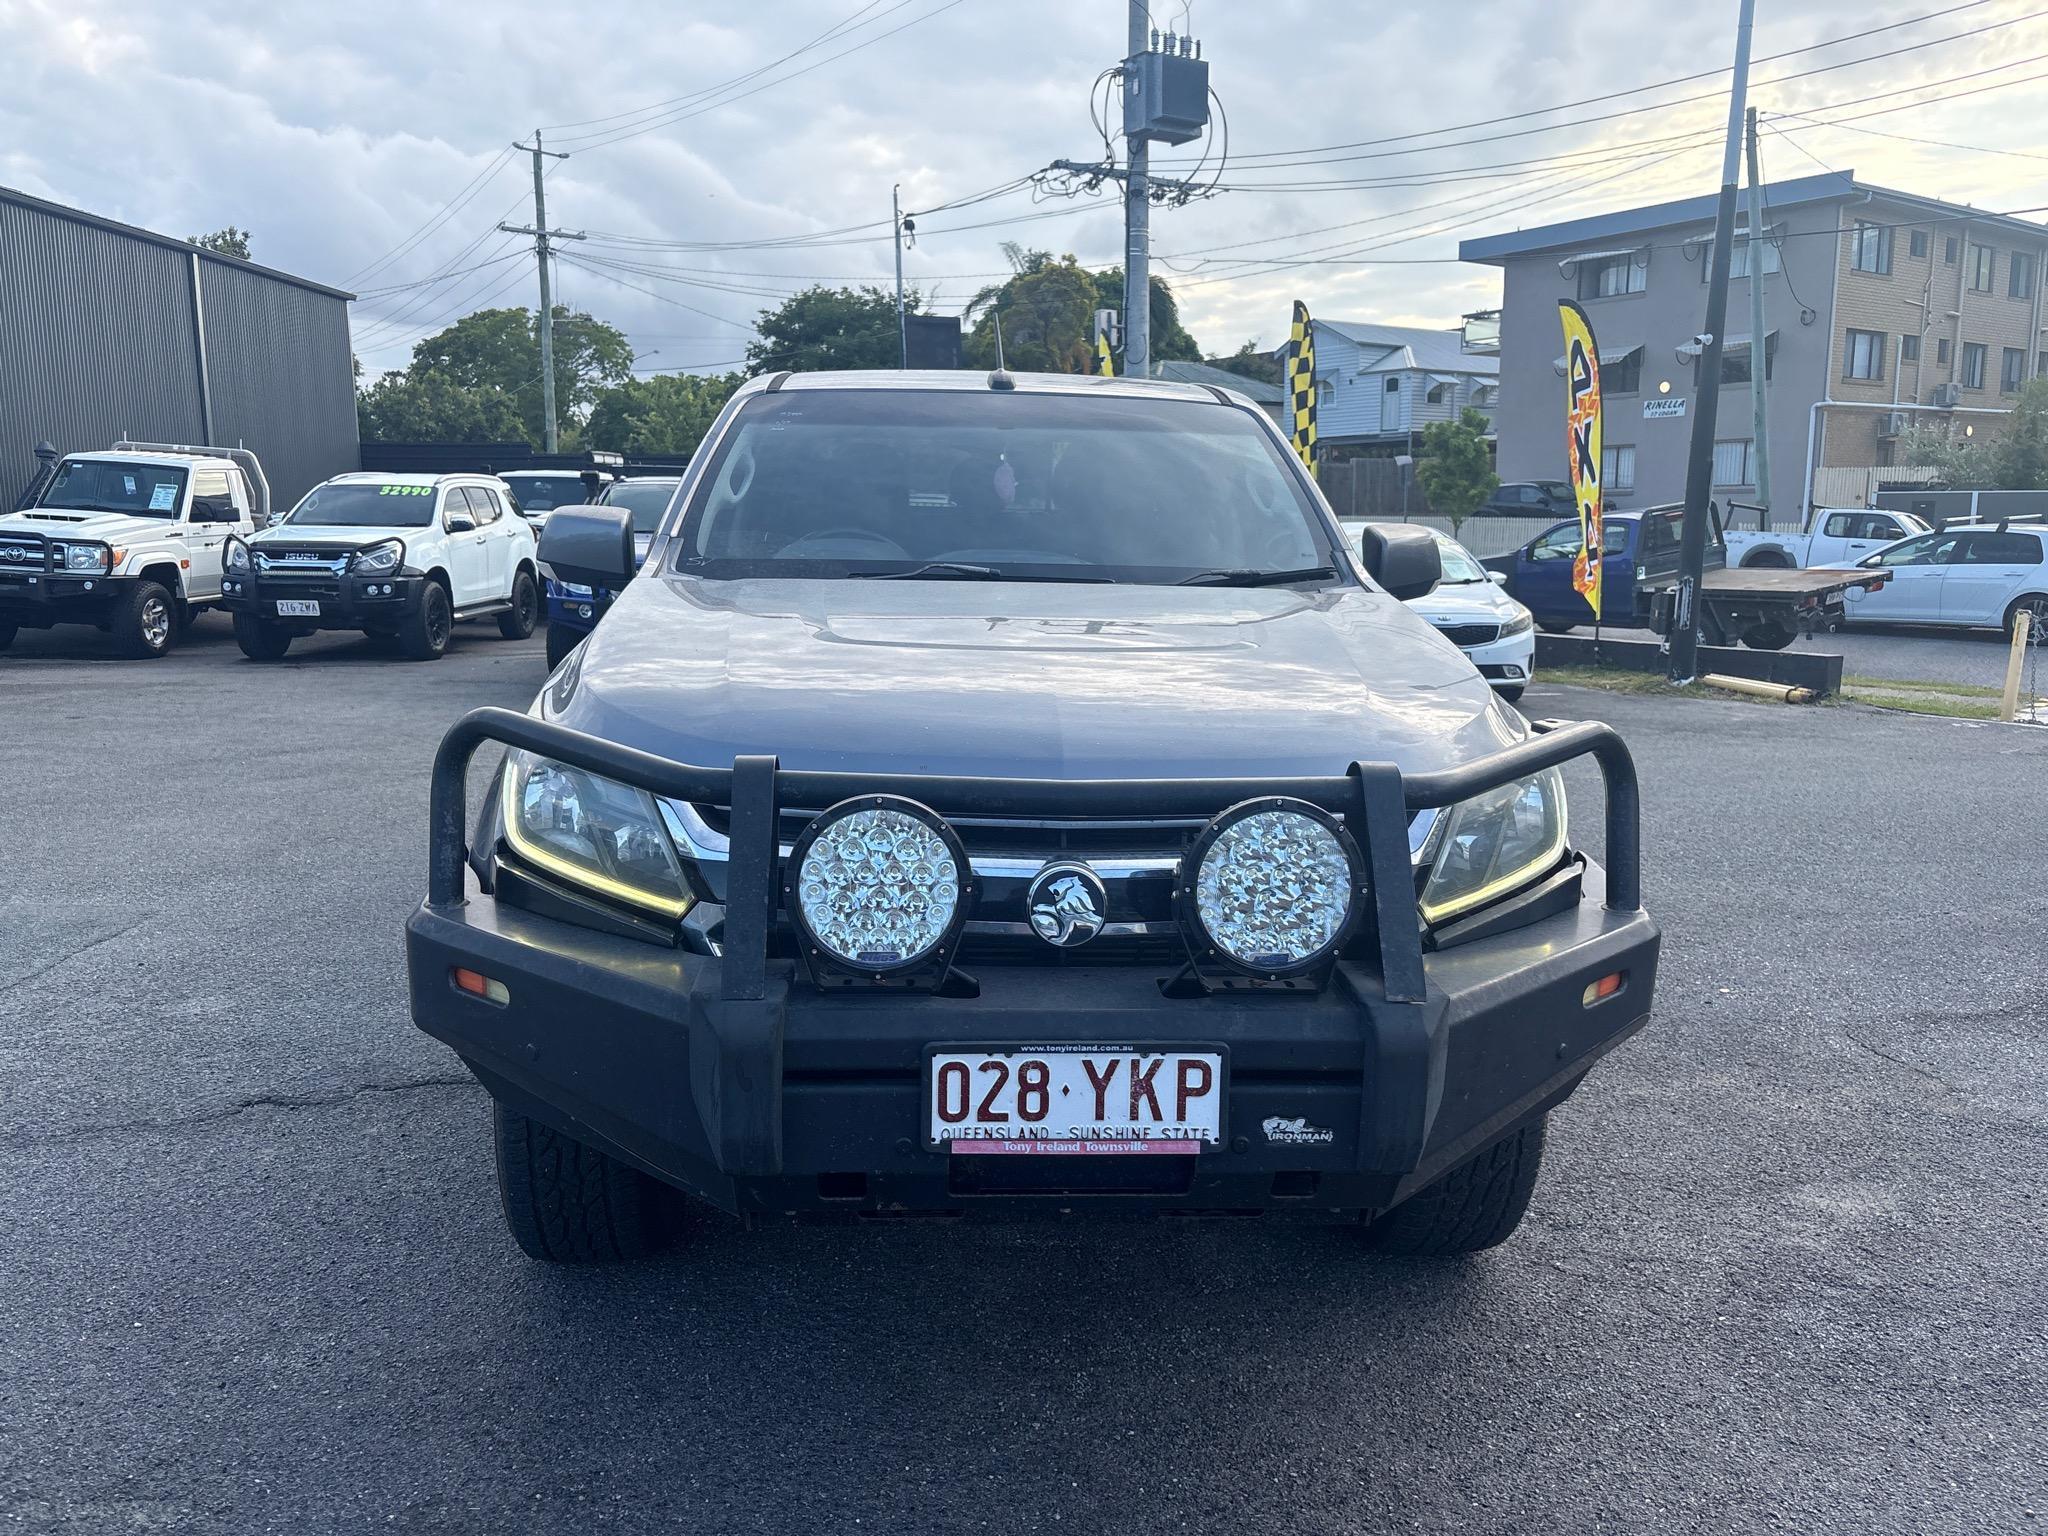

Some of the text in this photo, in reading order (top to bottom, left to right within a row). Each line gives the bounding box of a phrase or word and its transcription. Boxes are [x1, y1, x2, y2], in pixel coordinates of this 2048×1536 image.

[1645, 399, 1686, 411] RINELLA
[379, 485, 432, 497] 32990
[285, 552, 319, 560] ISUZU
[1021, 1044, 1134, 1053] www.tonyireland.com.au
[941, 1126, 1050, 1140] QUEENSLAND
[1069, 1126, 1151, 1140] SUNSHINE
[1162, 1127, 1211, 1140] STATE
[1272, 1132, 1329, 1140] IRONMAN
[1003, 1141, 1148, 1153] Tony Ireland Townsville
